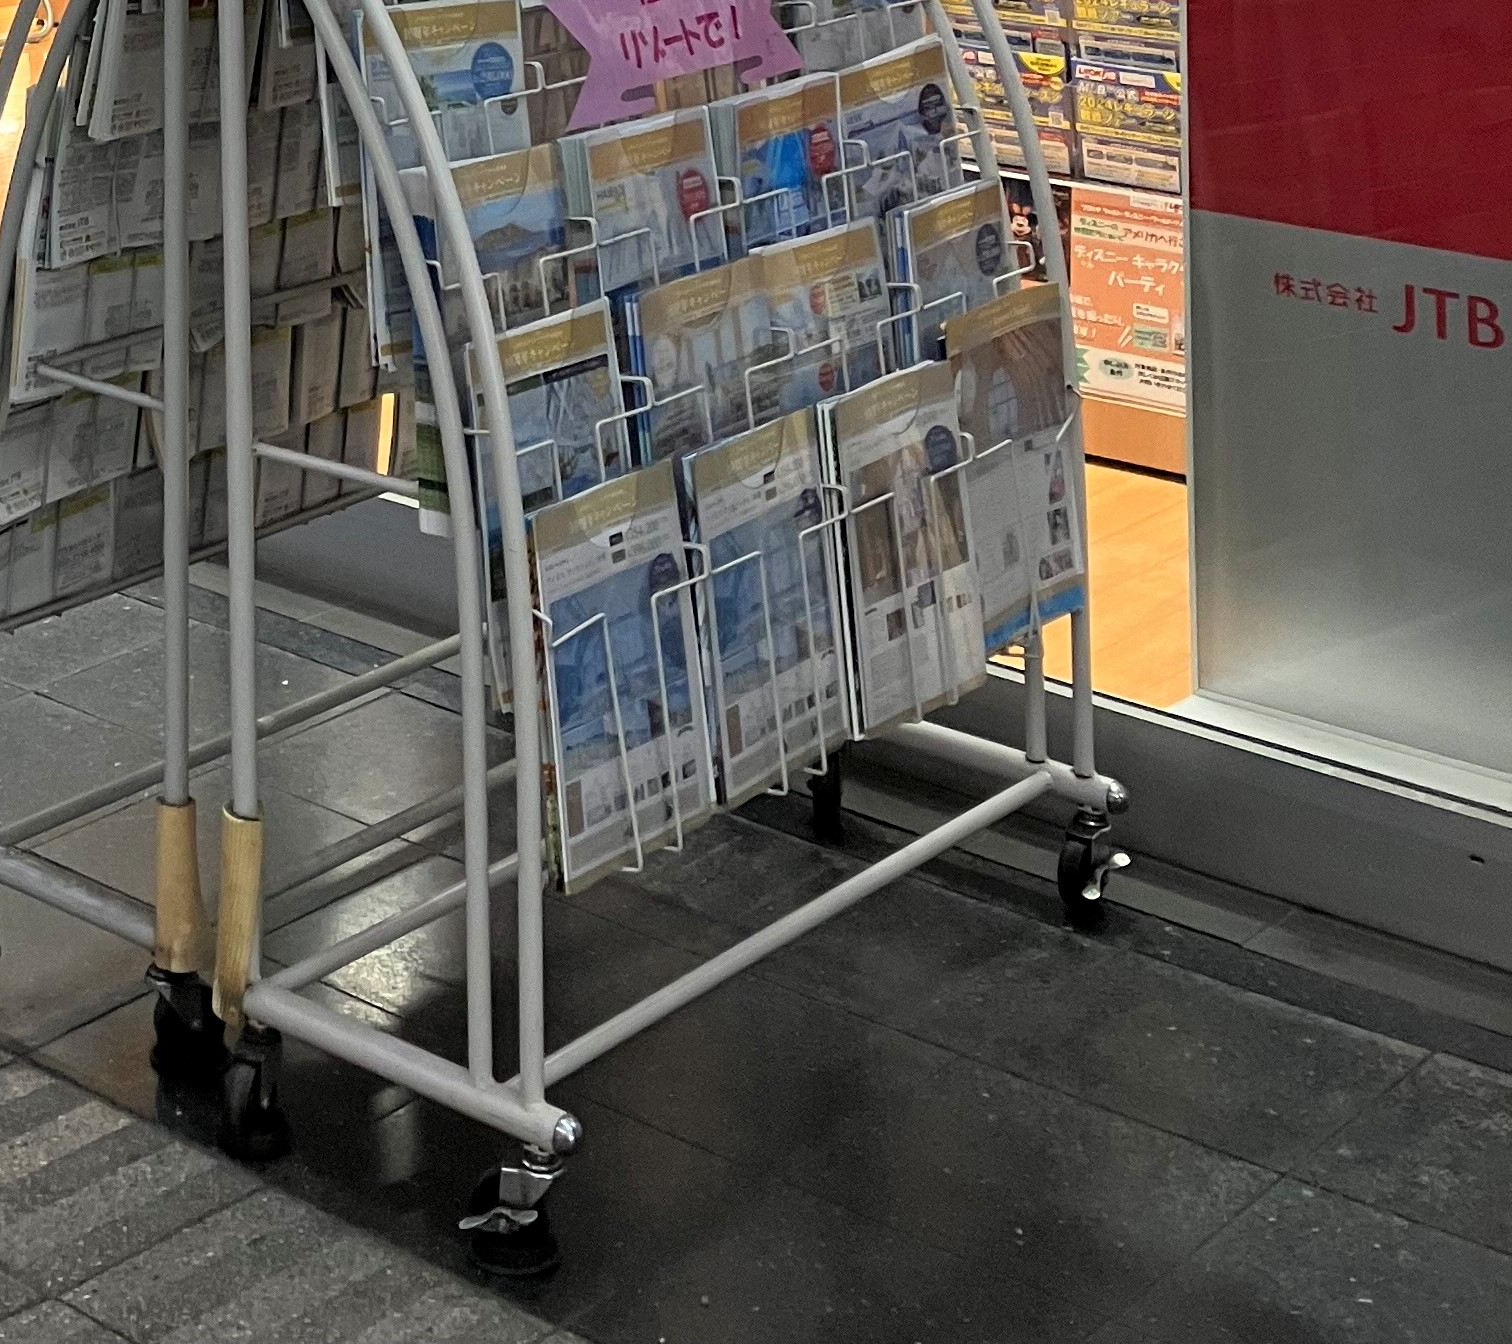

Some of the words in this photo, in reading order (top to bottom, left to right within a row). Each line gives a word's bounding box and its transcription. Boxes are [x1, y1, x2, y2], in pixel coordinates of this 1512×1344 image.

[1073, 244, 1130, 263] ディズニー
[1273, 270, 1379, 314] 株式会社
[1392, 284, 1506, 350] JTB
